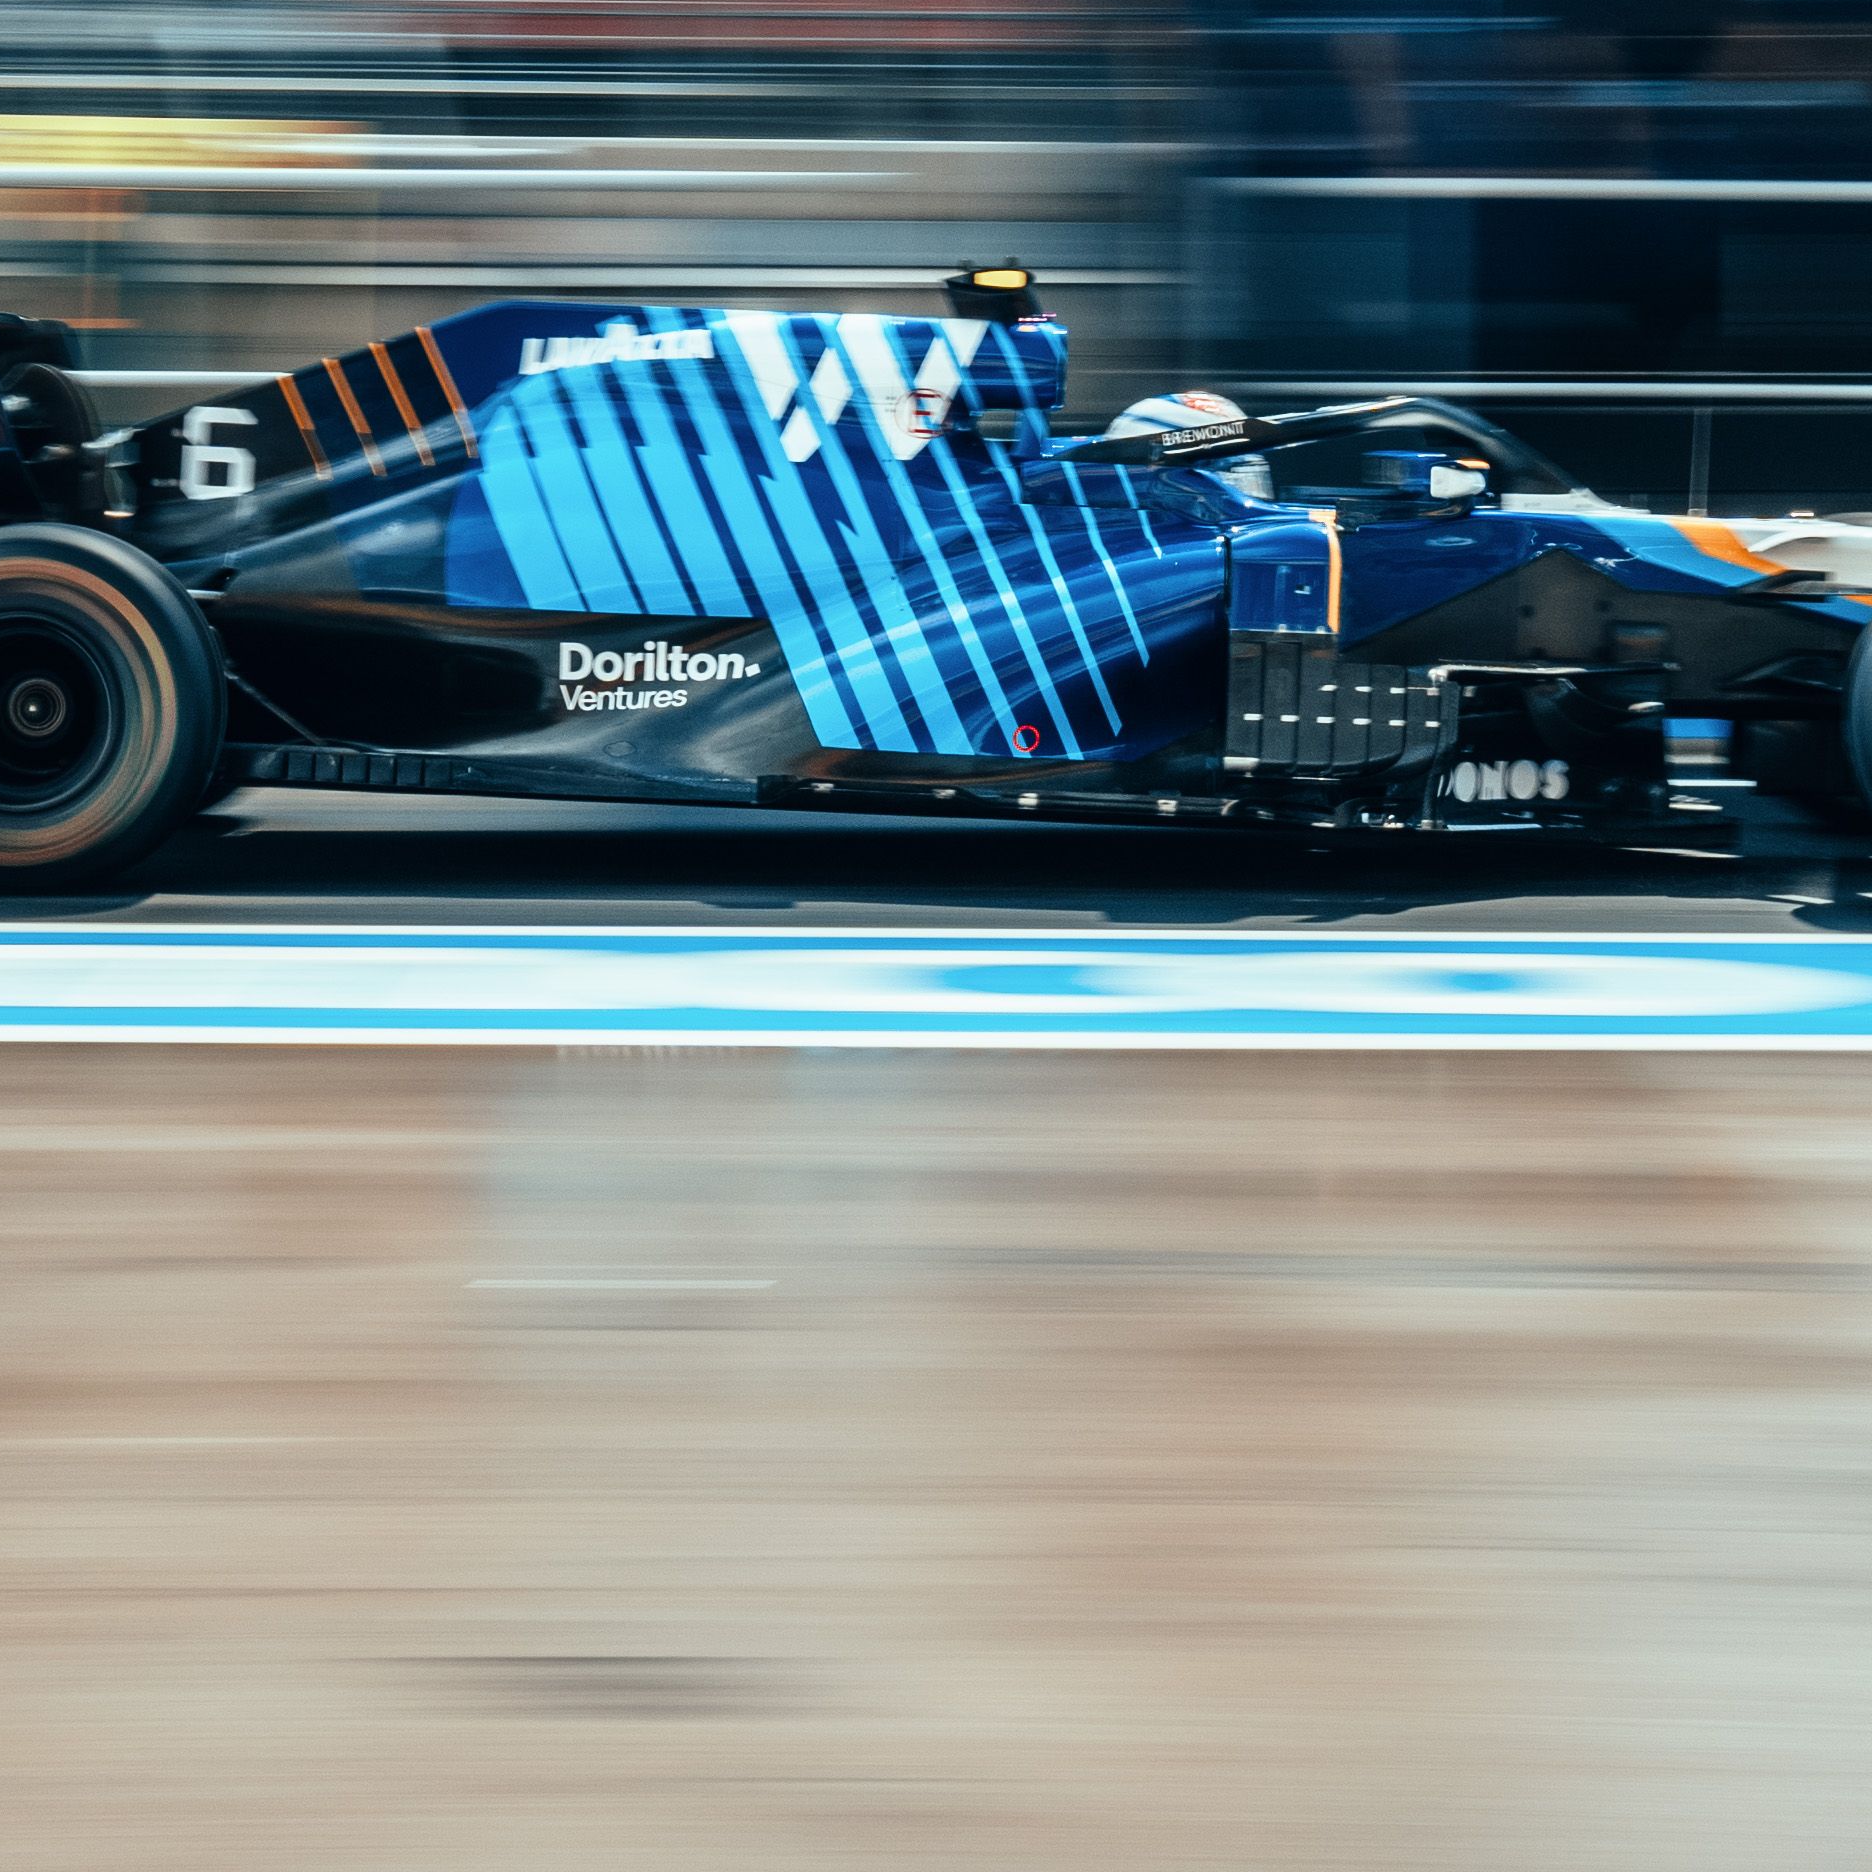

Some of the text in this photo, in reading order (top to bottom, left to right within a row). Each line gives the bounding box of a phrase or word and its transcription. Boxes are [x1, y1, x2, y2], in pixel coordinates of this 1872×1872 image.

[1161, 420, 1246, 447] BREMONT
[179, 405, 259, 501] 6
[559, 684, 688, 711] Ventures
[1437, 759, 1570, 803] ONOS
